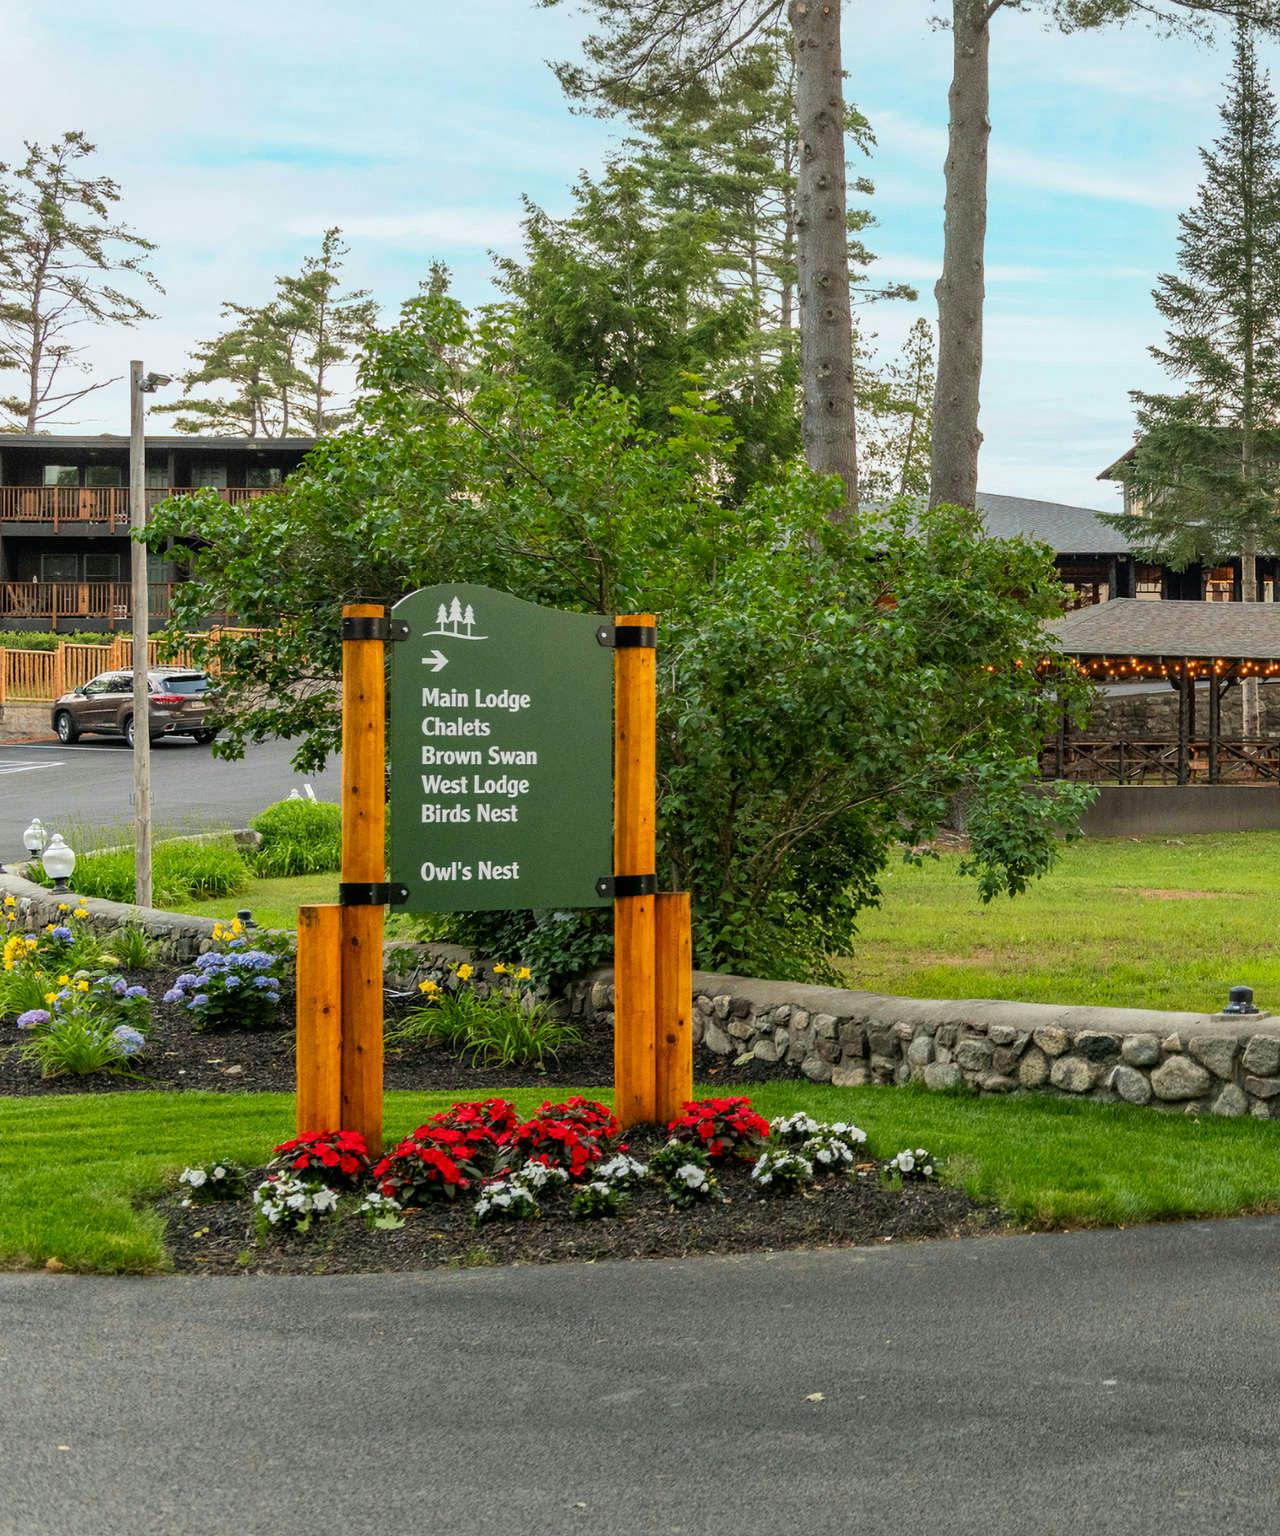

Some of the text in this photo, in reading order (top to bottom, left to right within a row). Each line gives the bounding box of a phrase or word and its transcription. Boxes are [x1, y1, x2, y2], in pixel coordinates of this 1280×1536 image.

[421, 687, 532, 713] Main Lodge
[421, 716, 491, 737] Chalets
[421, 745, 538, 766] Brown Swan
[422, 774, 530, 798] West Lodge
[421, 803, 519, 823] Birds Nest
[420, 861, 520, 882] Owl's Nest
